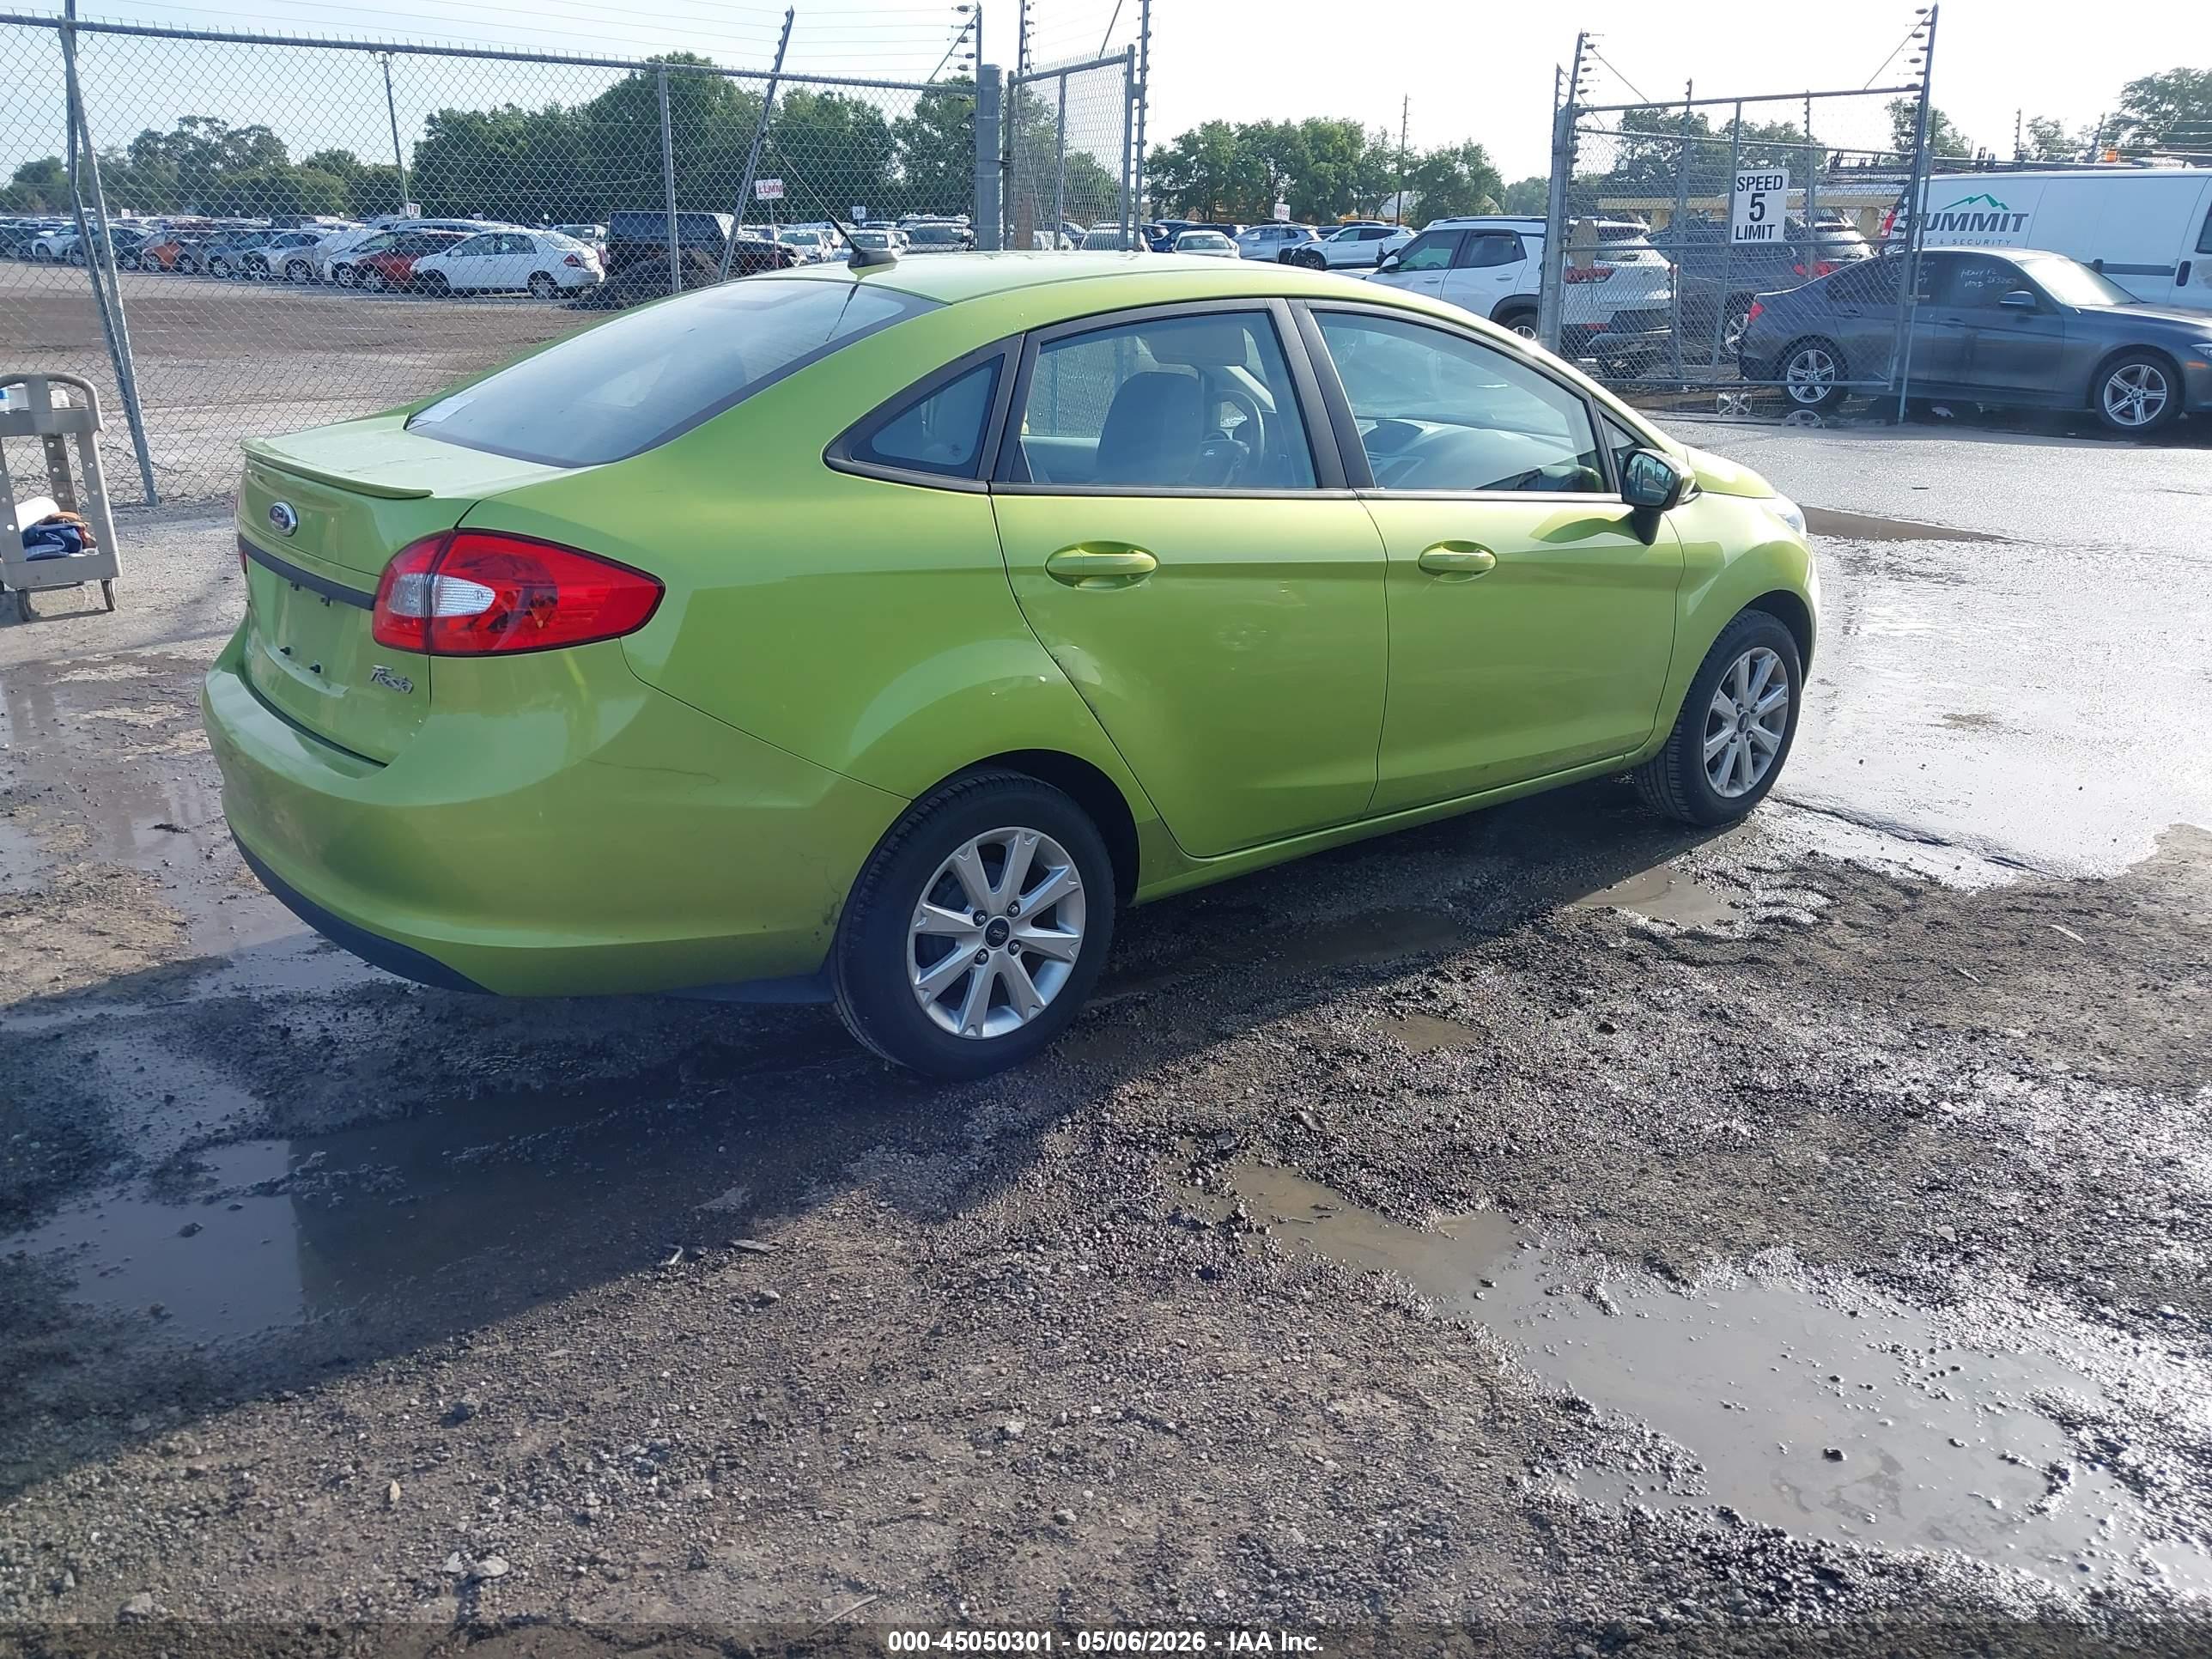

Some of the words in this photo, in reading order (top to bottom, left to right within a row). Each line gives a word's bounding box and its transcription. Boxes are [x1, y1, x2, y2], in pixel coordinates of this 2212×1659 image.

[1736, 175, 1784, 191] SPEED
[1749, 192, 1766, 222] 5
[1915, 212, 2029, 232] UMMIT
[1735, 224, 1776, 240] LIMIT
[1952, 238, 2012, 246] SECURITY
